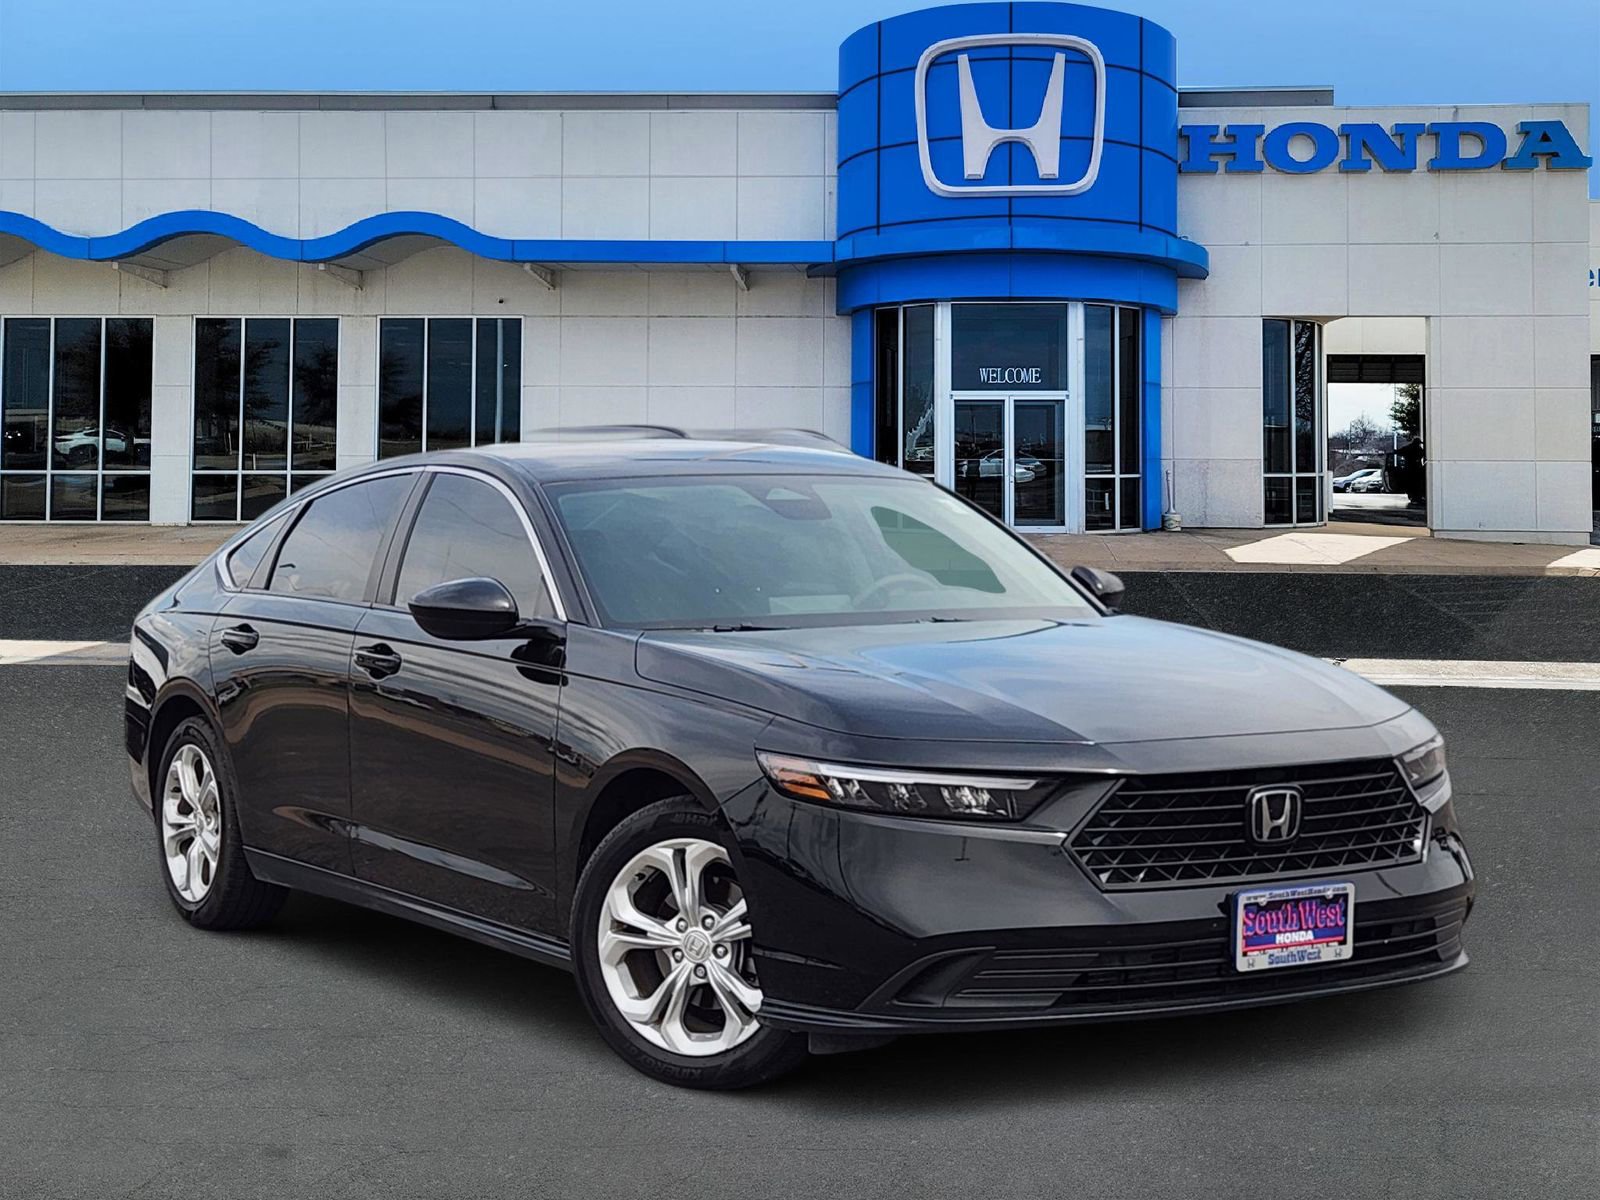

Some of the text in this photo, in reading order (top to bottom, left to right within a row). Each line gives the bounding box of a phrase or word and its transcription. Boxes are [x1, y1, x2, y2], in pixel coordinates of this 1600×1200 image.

[1179, 121, 1593, 174] HONDA
[979, 367, 1042, 384] WELCOME
[1246, 886, 1348, 901] wwwSouthWestHondacom
[1275, 930, 1315, 945] HONDA
